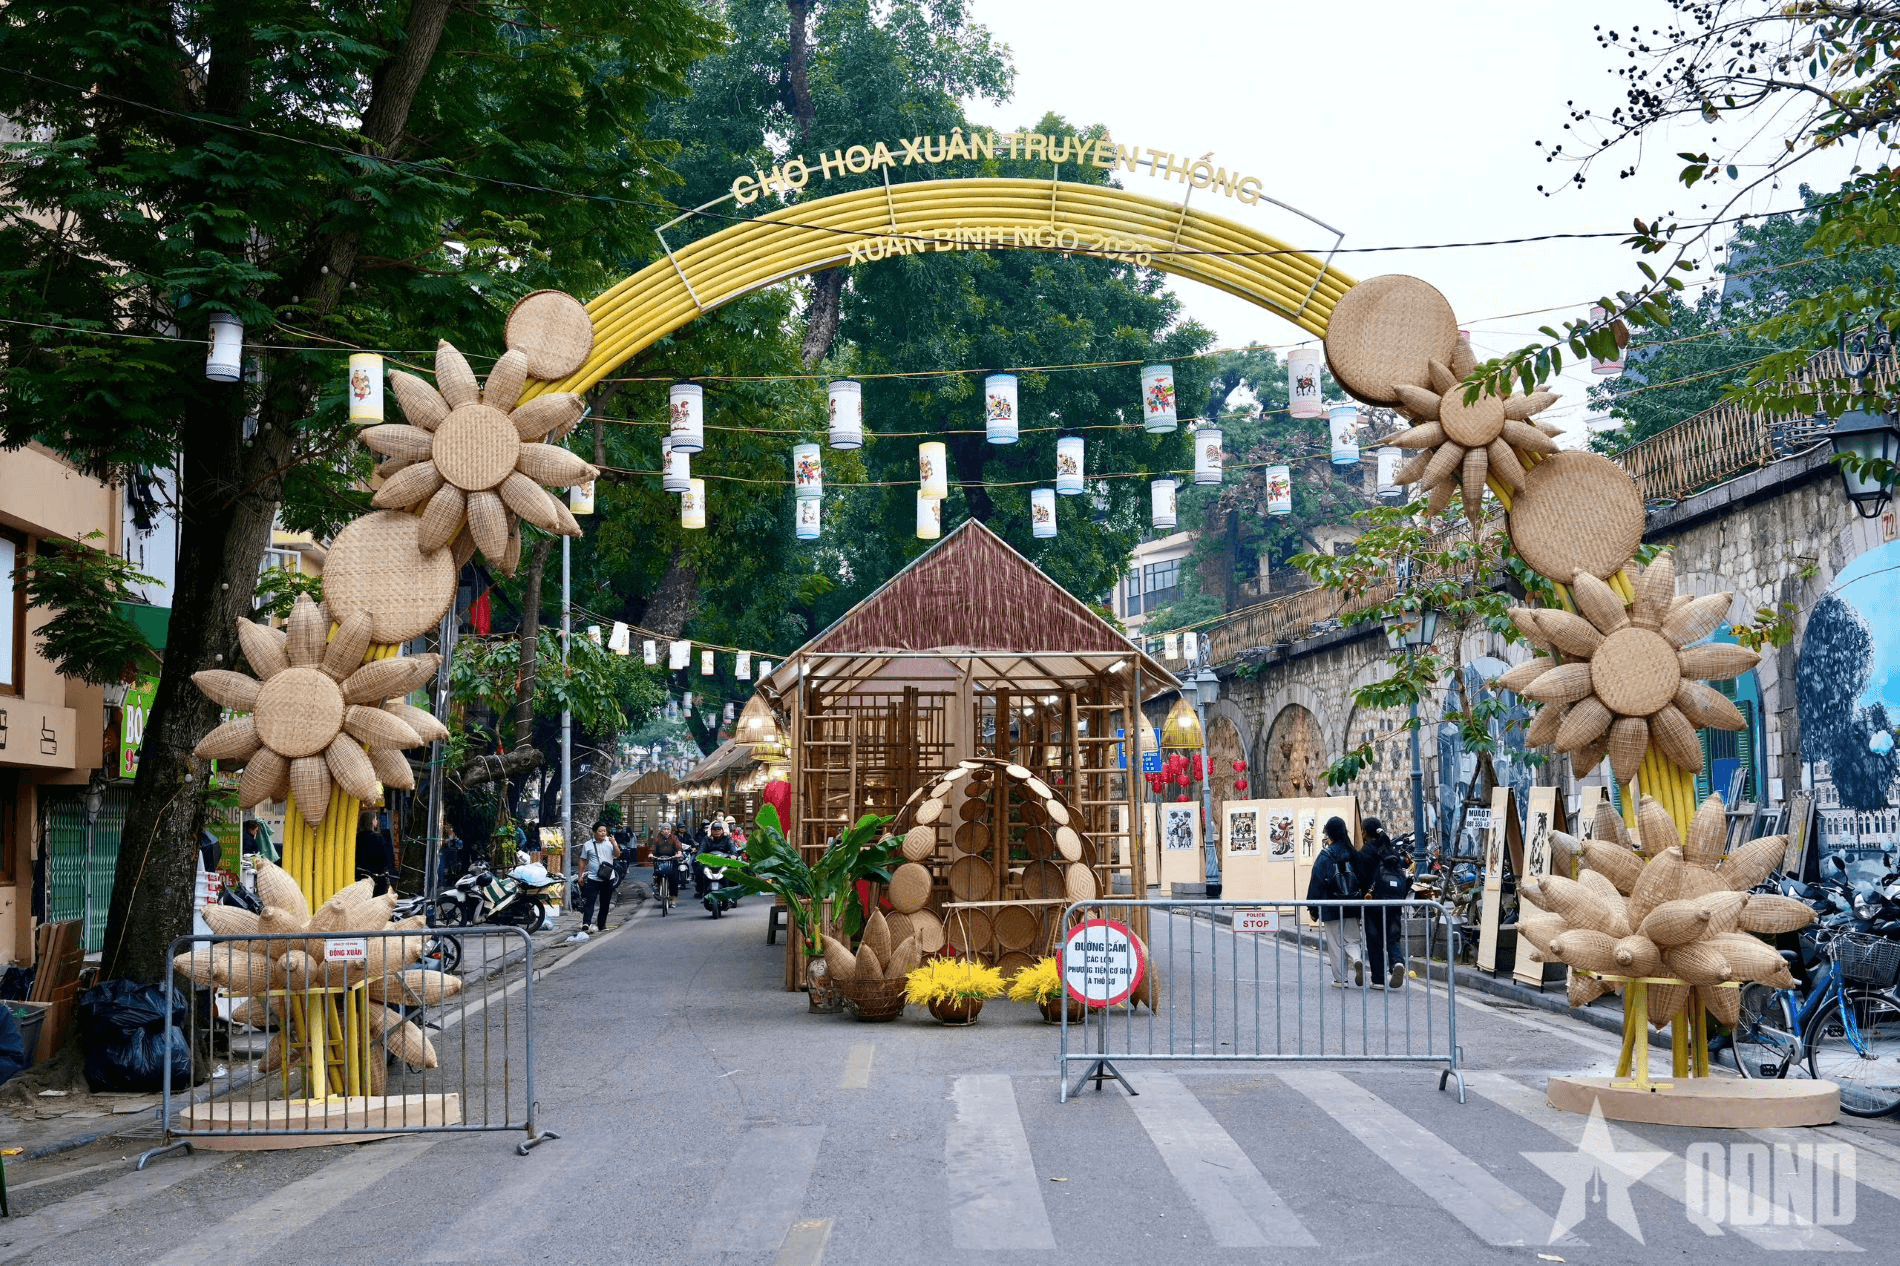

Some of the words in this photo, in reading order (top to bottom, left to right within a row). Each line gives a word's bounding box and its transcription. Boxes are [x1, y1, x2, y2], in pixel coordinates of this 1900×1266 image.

[732, 154, 810, 205] CHỢ
[819, 141, 896, 180] HOA
[899, 126, 994, 167] XUÂN
[1146, 149, 1264, 206] THỐNG
[846, 226, 926, 267] XUÂN
[1086, 232, 1153, 267] 2026
[1243, 920, 1269, 928] STOP
[1107, 940, 1126, 952] CẤM
